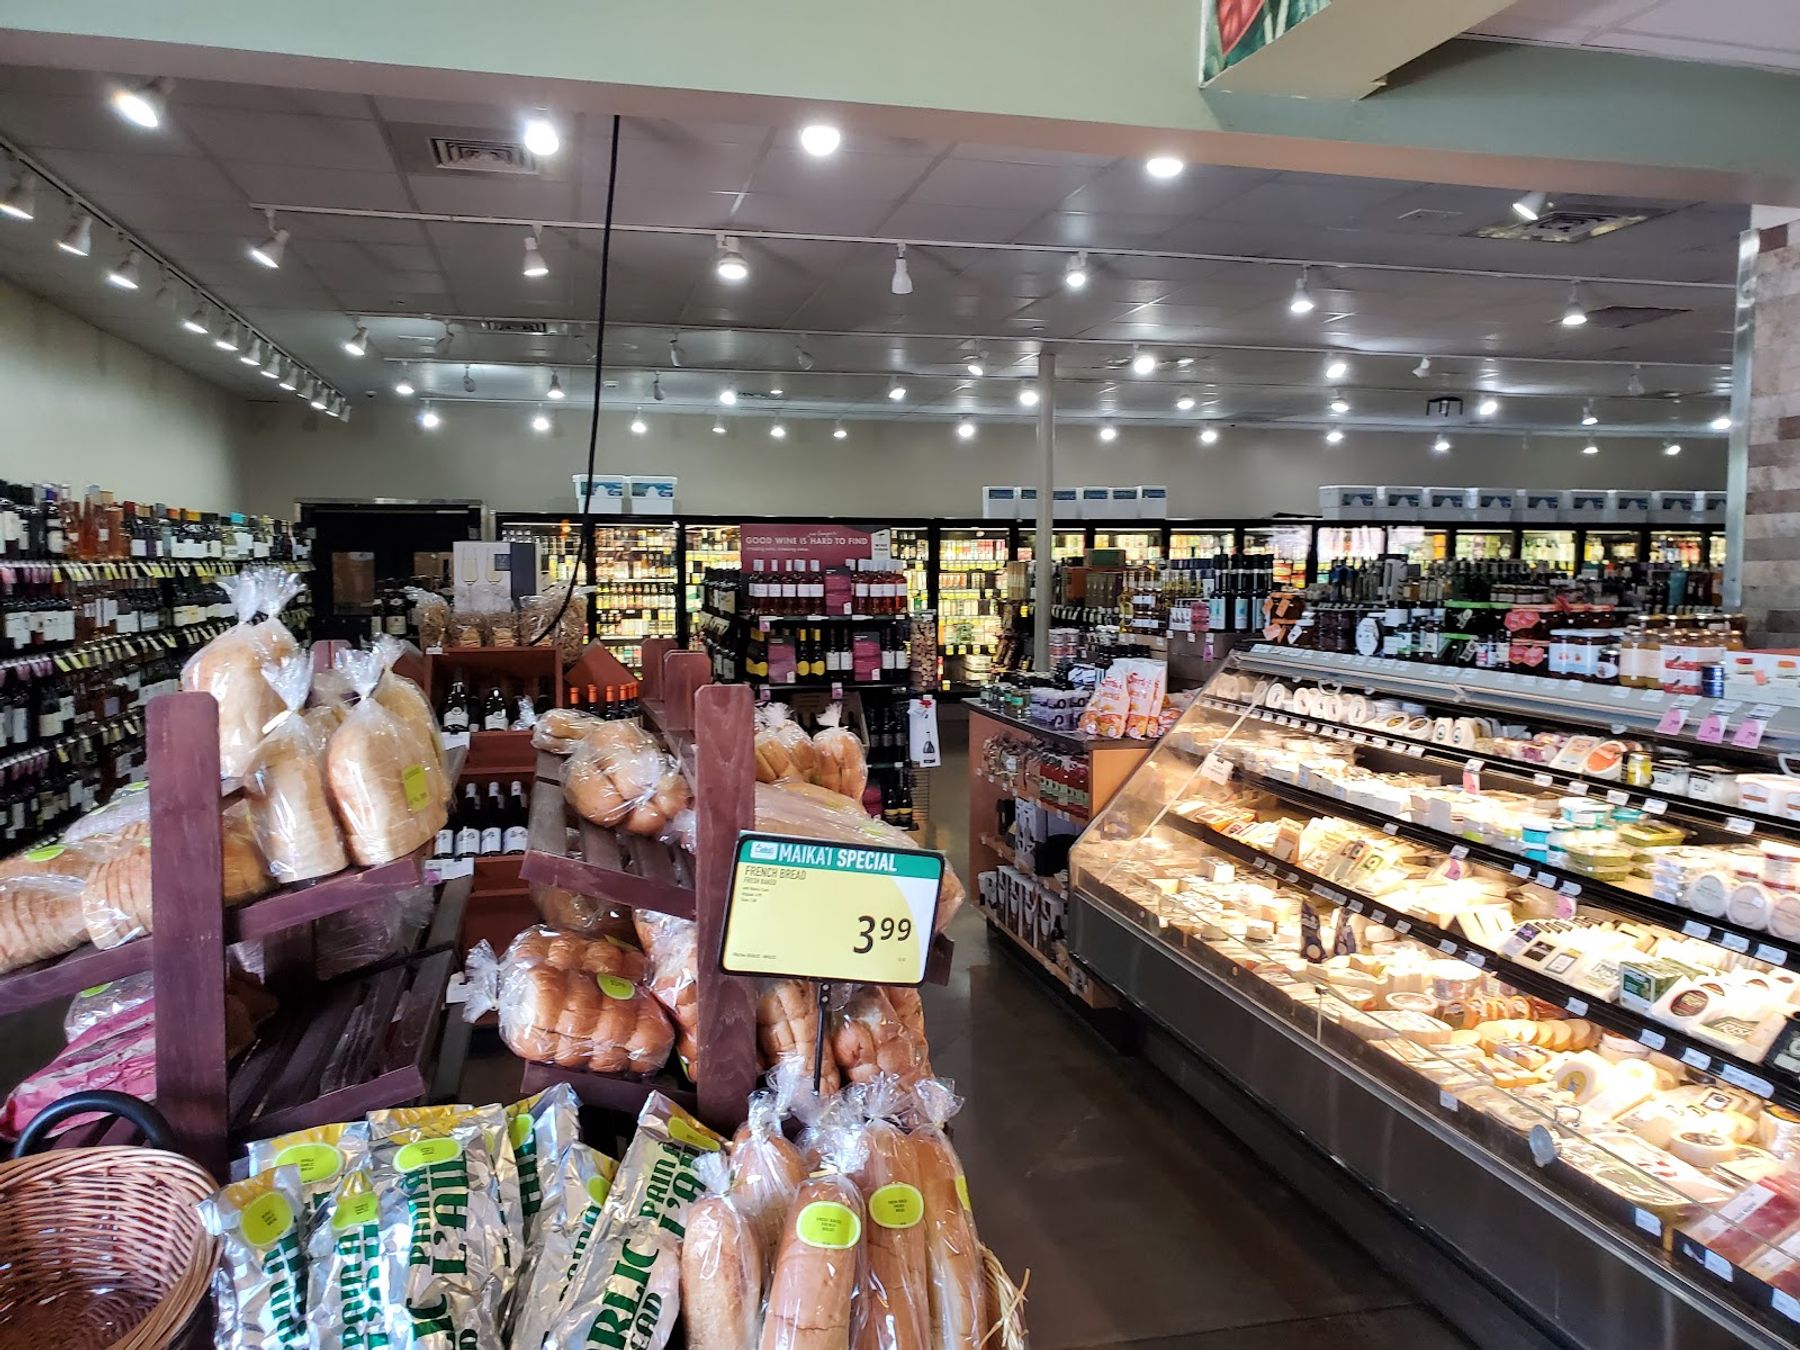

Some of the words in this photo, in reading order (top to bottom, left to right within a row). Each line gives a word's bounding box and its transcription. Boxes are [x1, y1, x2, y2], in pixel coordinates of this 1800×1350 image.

[745, 536, 773, 545] GOOD
[774, 536, 798, 545] WINE
[799, 537, 808, 545] IS
[810, 537, 834, 545] HARD
[834, 537, 846, 545] TO
[848, 537, 868, 545] FIND
[836, 848, 898, 872] SPECIAL
[744, 864, 778, 879] FRENCH
[779, 867, 808, 881] BREAD
[638, 1158, 678, 1219] PAIN
[408, 1190, 432, 1266] PAIN
